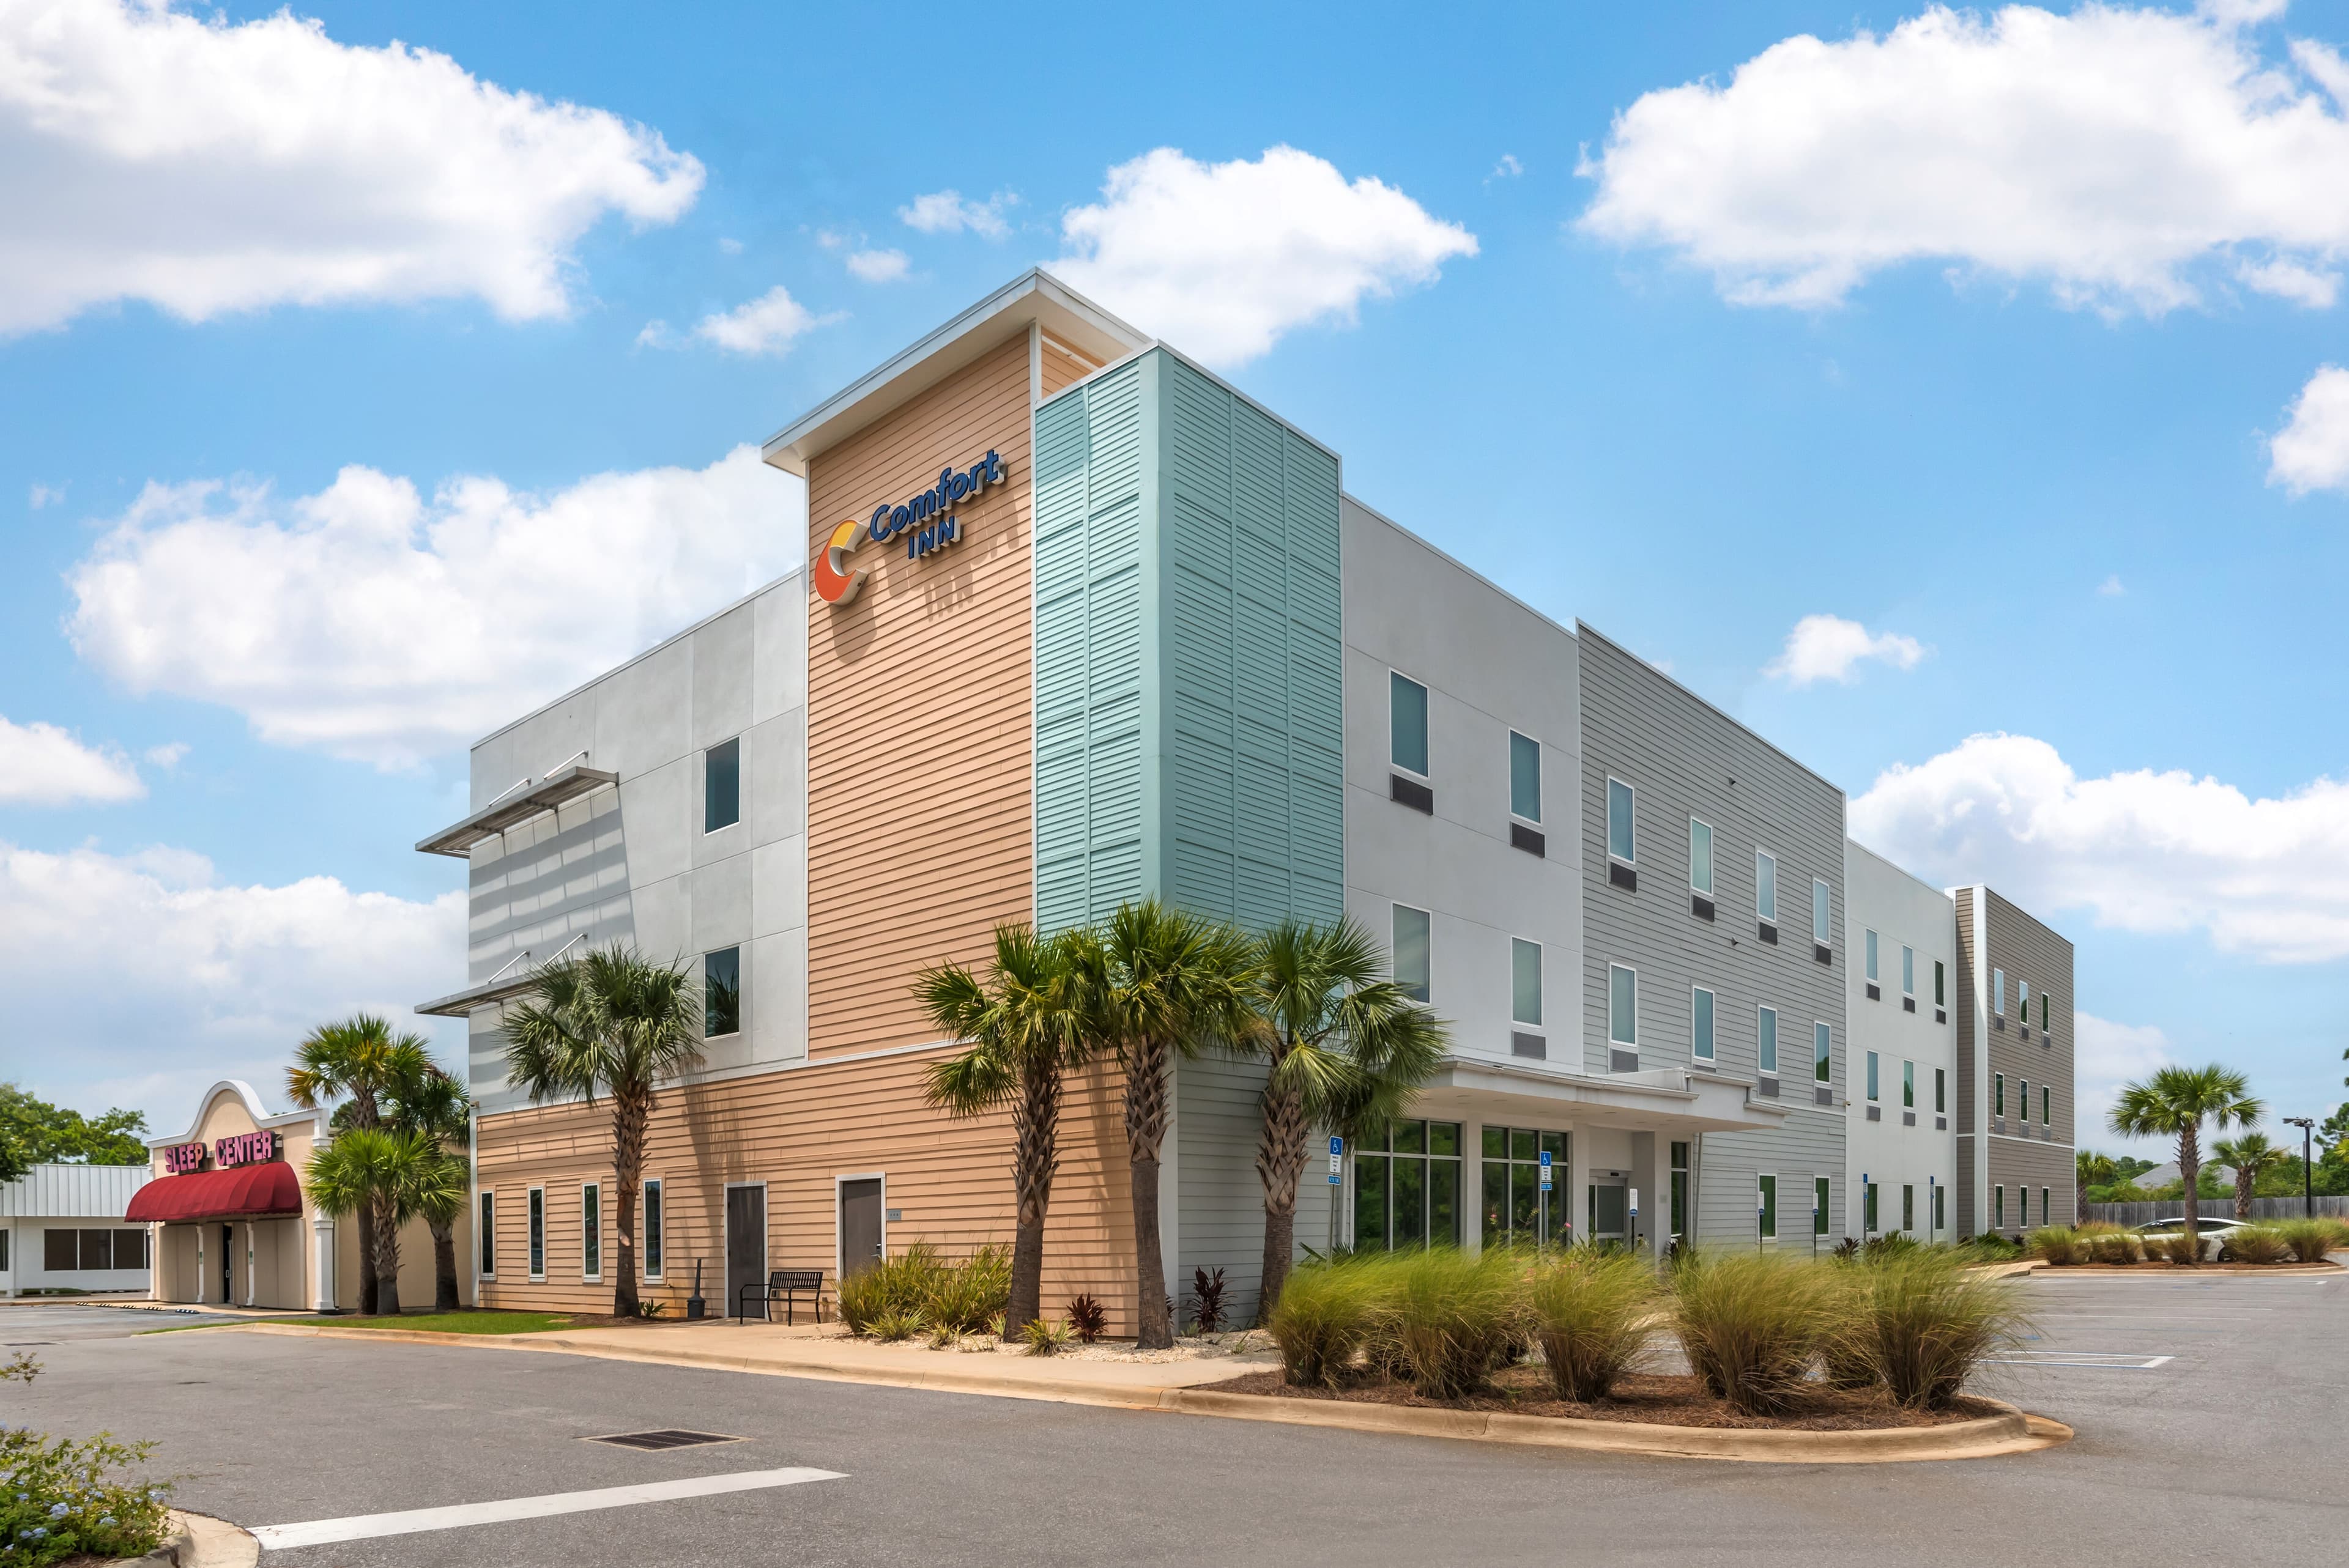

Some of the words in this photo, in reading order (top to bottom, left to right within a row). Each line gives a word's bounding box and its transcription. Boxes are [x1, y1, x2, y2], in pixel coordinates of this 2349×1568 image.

[869, 449, 1000, 542] Comfort
[908, 516, 956, 560] INN
[165, 1142, 204, 1173] SLEEP
[215, 1131, 273, 1166] CENTER
